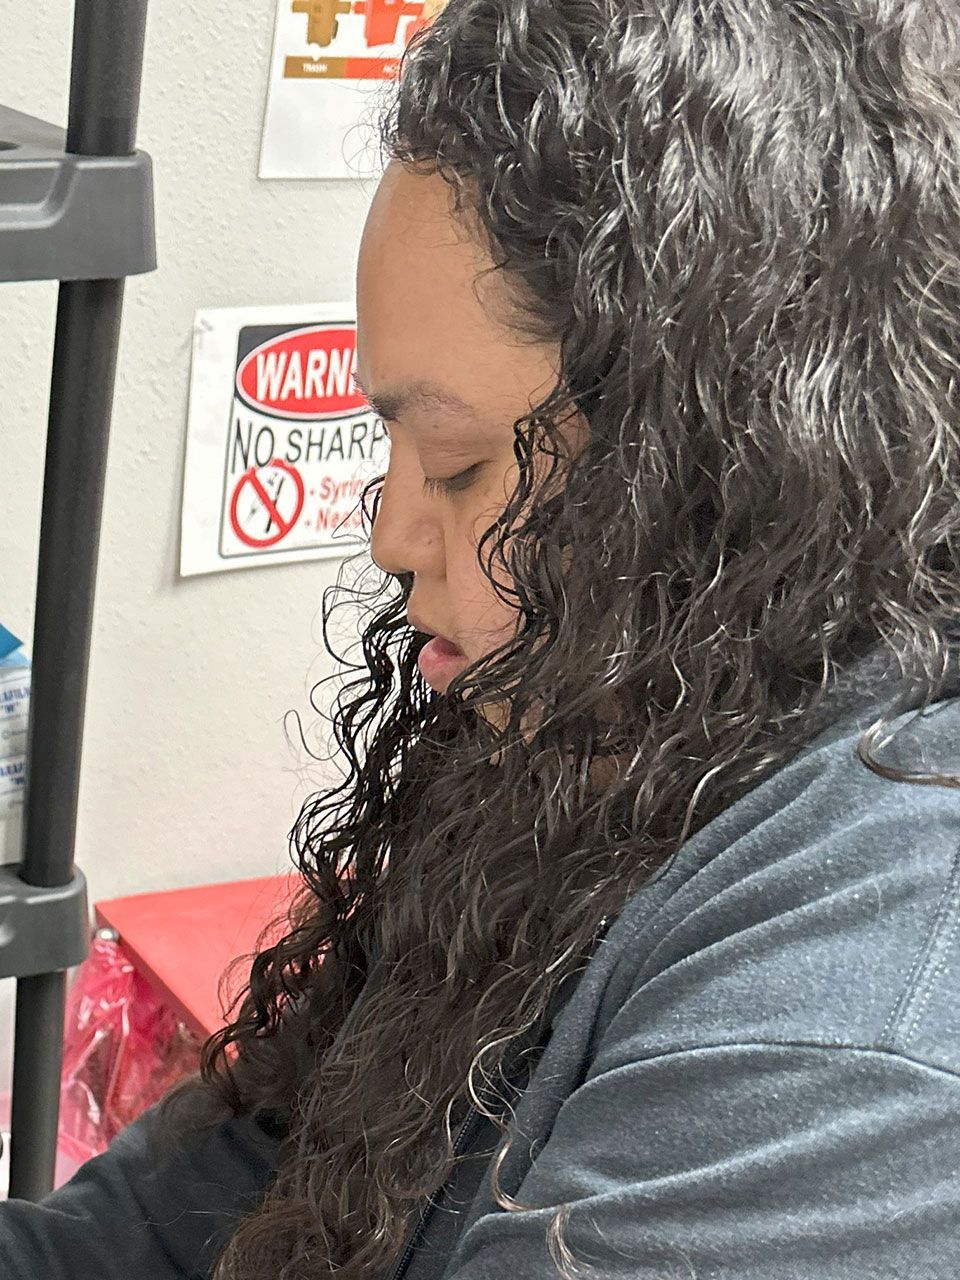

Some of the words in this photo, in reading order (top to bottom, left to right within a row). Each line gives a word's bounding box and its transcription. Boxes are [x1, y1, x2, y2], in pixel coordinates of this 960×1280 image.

[256, 347, 358, 401] WARNI
[231, 419, 275, 474] NO
[286, 418, 388, 463] SHARP
[319, 476, 365, 505] Syrin
